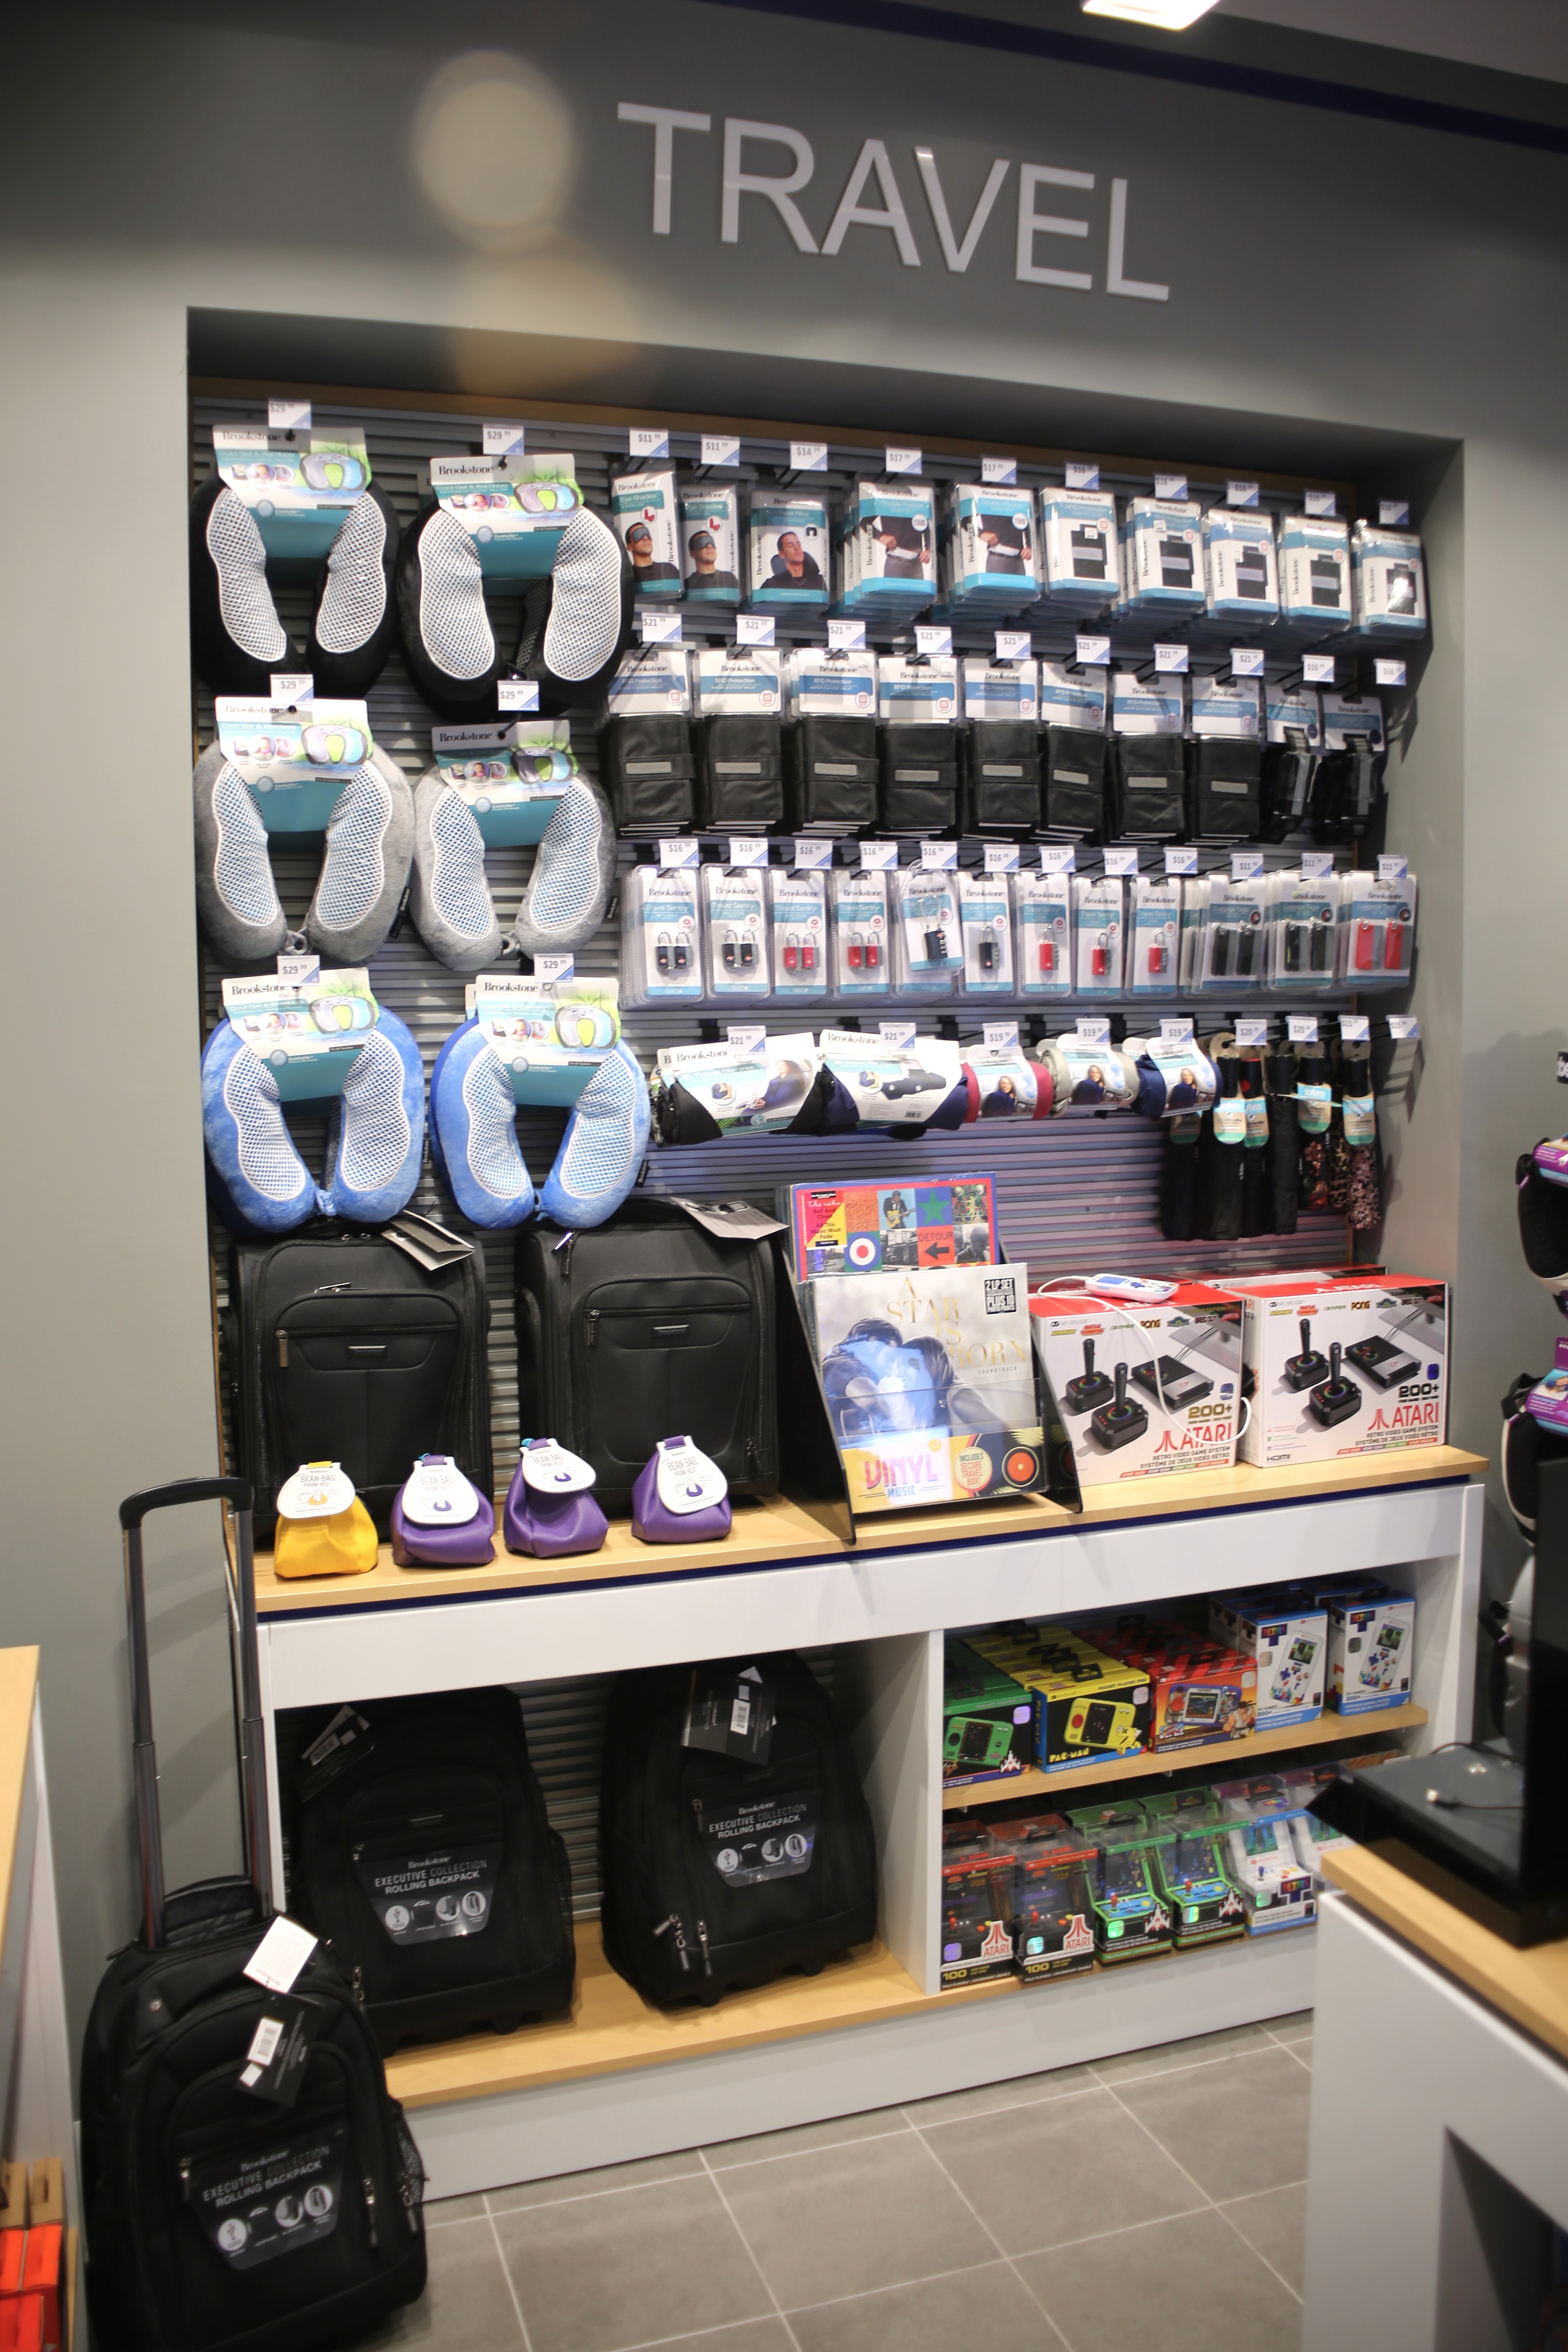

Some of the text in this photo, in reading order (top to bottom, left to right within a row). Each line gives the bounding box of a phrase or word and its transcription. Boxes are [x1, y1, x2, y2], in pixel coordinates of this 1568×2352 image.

[617, 102, 1169, 301] TRAVEL
[269, 403, 285, 412] $29
[223, 431, 281, 441] Brookstone
[487, 431, 502, 440] $29
[705, 442, 720, 451] $11
[796, 447, 811, 456] $14
[889, 454, 903, 462] $17
[439, 466, 493, 475] Brookstone
[983, 463, 996, 472] $17
[633, 493, 656, 501] Shades
[643, 618, 658, 626] $21
[745, 621, 759, 630] $21
[829, 626, 844, 634] $21
[920, 632, 934, 640] $21
[1003, 636, 1017, 645] $21
[281, 681, 296, 689] $29
[499, 691, 515, 699] $29
[439, 732, 492, 742] Brookstone
[668, 844, 683, 853] $16
[739, 844, 753, 852] $16
[799, 846, 813, 855] $16
[1239, 862, 1251, 870] $11
[649, 889, 692, 897] Brookstone
[715, 887, 758, 895] Brookstone
[1214, 905, 1234, 913] Luggage
[543, 960, 558, 969] $29
[282, 966, 298, 975] $29
[484, 982, 539, 992] Brookstone
[1082, 1028, 1096, 1037] $19
[1168, 1028, 1182, 1037] $19
[1240, 1028, 1253, 1036] $20
[1292, 1025, 1305, 1033] $20
[730, 1037, 744, 1045] $21
[989, 1032, 1003, 1042] $19
[722, 1066, 755, 1074] Blanket
[1304, 1087, 1326, 1098] totes
[918, 1232, 953, 1242] DETOUR
[899, 1276, 918, 1300] A
[986, 1279, 1013, 1290] 2 LP SET
[987, 1295, 1006, 1307] PLUS
[1351, 1300, 1370, 1310] PONG
[886, 1296, 962, 1325] STAR
[1140, 1319, 1160, 1328] PONG
[935, 1321, 962, 1345] IS
[950, 1339, 1027, 1369] BORN
[978, 1366, 1018, 1374] SOUNDTRACK
[1399, 1383, 1439, 1398] 200+
[1188, 1403, 1232, 1419] 200+
[1391, 1401, 1439, 1428] ATARI
[1179, 1423, 1231, 1450] ATARI
[1355, 1437, 1380, 1446] SYSTÈME
[532, 1453, 564, 1464] BEAN BAG
[959, 1452, 984, 1463] INCLUDES
[1267, 1454, 1291, 1462] HDMI
[667, 1456, 698, 1471] BEAN BAG
[960, 1461, 983, 1470] SECURE
[1140, 1461, 1167, 1469] SYSTÈME
[864, 1454, 938, 1490] VINYL
[961, 1469, 984, 1479] TRAVEL
[420, 1475, 454, 1485] BEAN BAG
[887, 1485, 916, 1498] MUSIC
[1351, 1612, 1375, 1624] TETRIS
[1262, 1625, 1287, 1637] TETRIS
[1049, 1748, 1089, 1762] PAC-MAN
[709, 1803, 807, 1833] EXECUTIVE COLLECTION
[717, 1814, 801, 1839] ROLLING BACKPACK
[374, 1859, 488, 1888] EXECUTIVE COLLECTION
[385, 1871, 480, 1895] ROLLING BACKPACK
[1281, 1880, 1311, 1893] TETRIS
[1065, 1936, 1091, 1950] ATARI
[984, 1942, 1009, 1957] ATARI
[1025, 1962, 1050, 1973] 100
[942, 1968, 967, 1980] 100
[203, 2145, 329, 2202] EXECUTIVE COLLECTION
[216, 2160, 322, 2208] ROLLING BACKPACK
